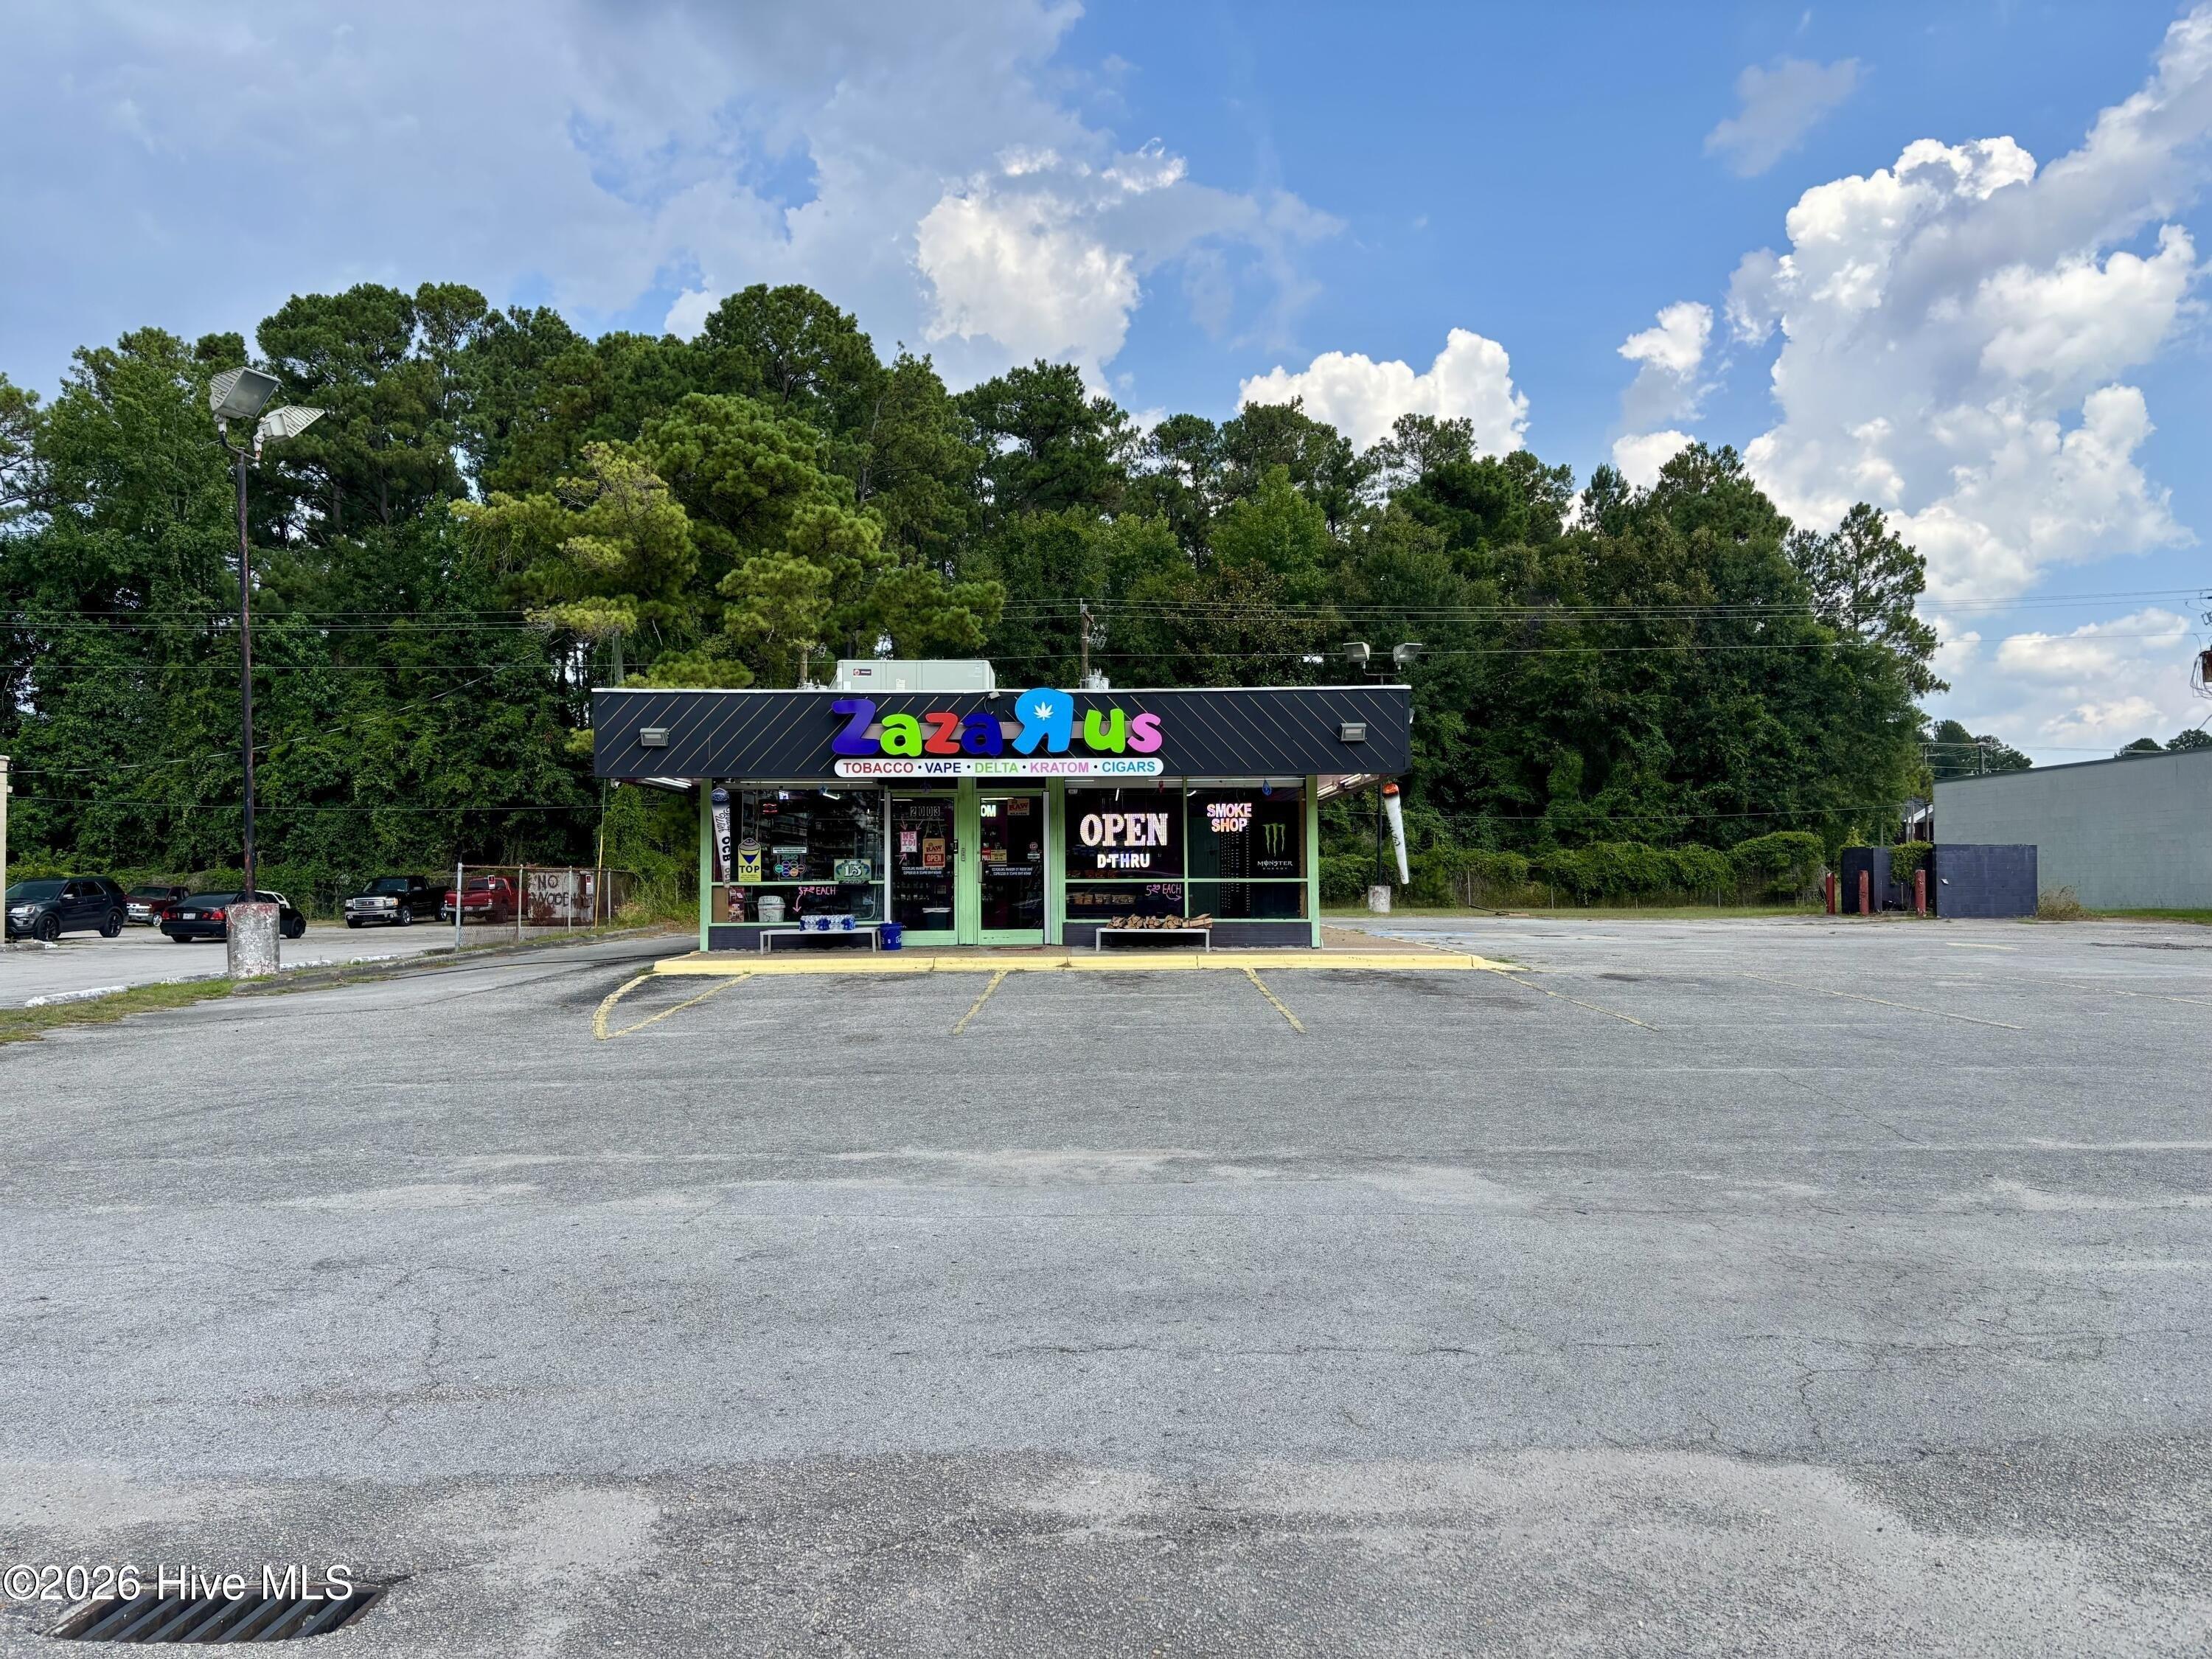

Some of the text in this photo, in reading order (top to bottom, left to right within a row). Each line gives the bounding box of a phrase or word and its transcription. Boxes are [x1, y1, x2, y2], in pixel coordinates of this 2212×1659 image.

[832, 699, 1003, 757] Zaza
[1084, 709, 1162, 754] us
[844, 762, 1155, 773] TOBACCO VAPE DELTA KRATOM CIGARS
[911, 806, 940, 816] 2003
[1009, 802, 1028, 810] RAW
[1206, 803, 1252, 818] SMOKE
[1079, 813, 1169, 846] OPEN
[1211, 818, 1248, 832] SHOP
[1097, 854, 1150, 868] D-THRU
[538, 874, 558, 888] NO
[816, 886, 835, 895] EACH
[1163, 883, 1181, 894] EACH
